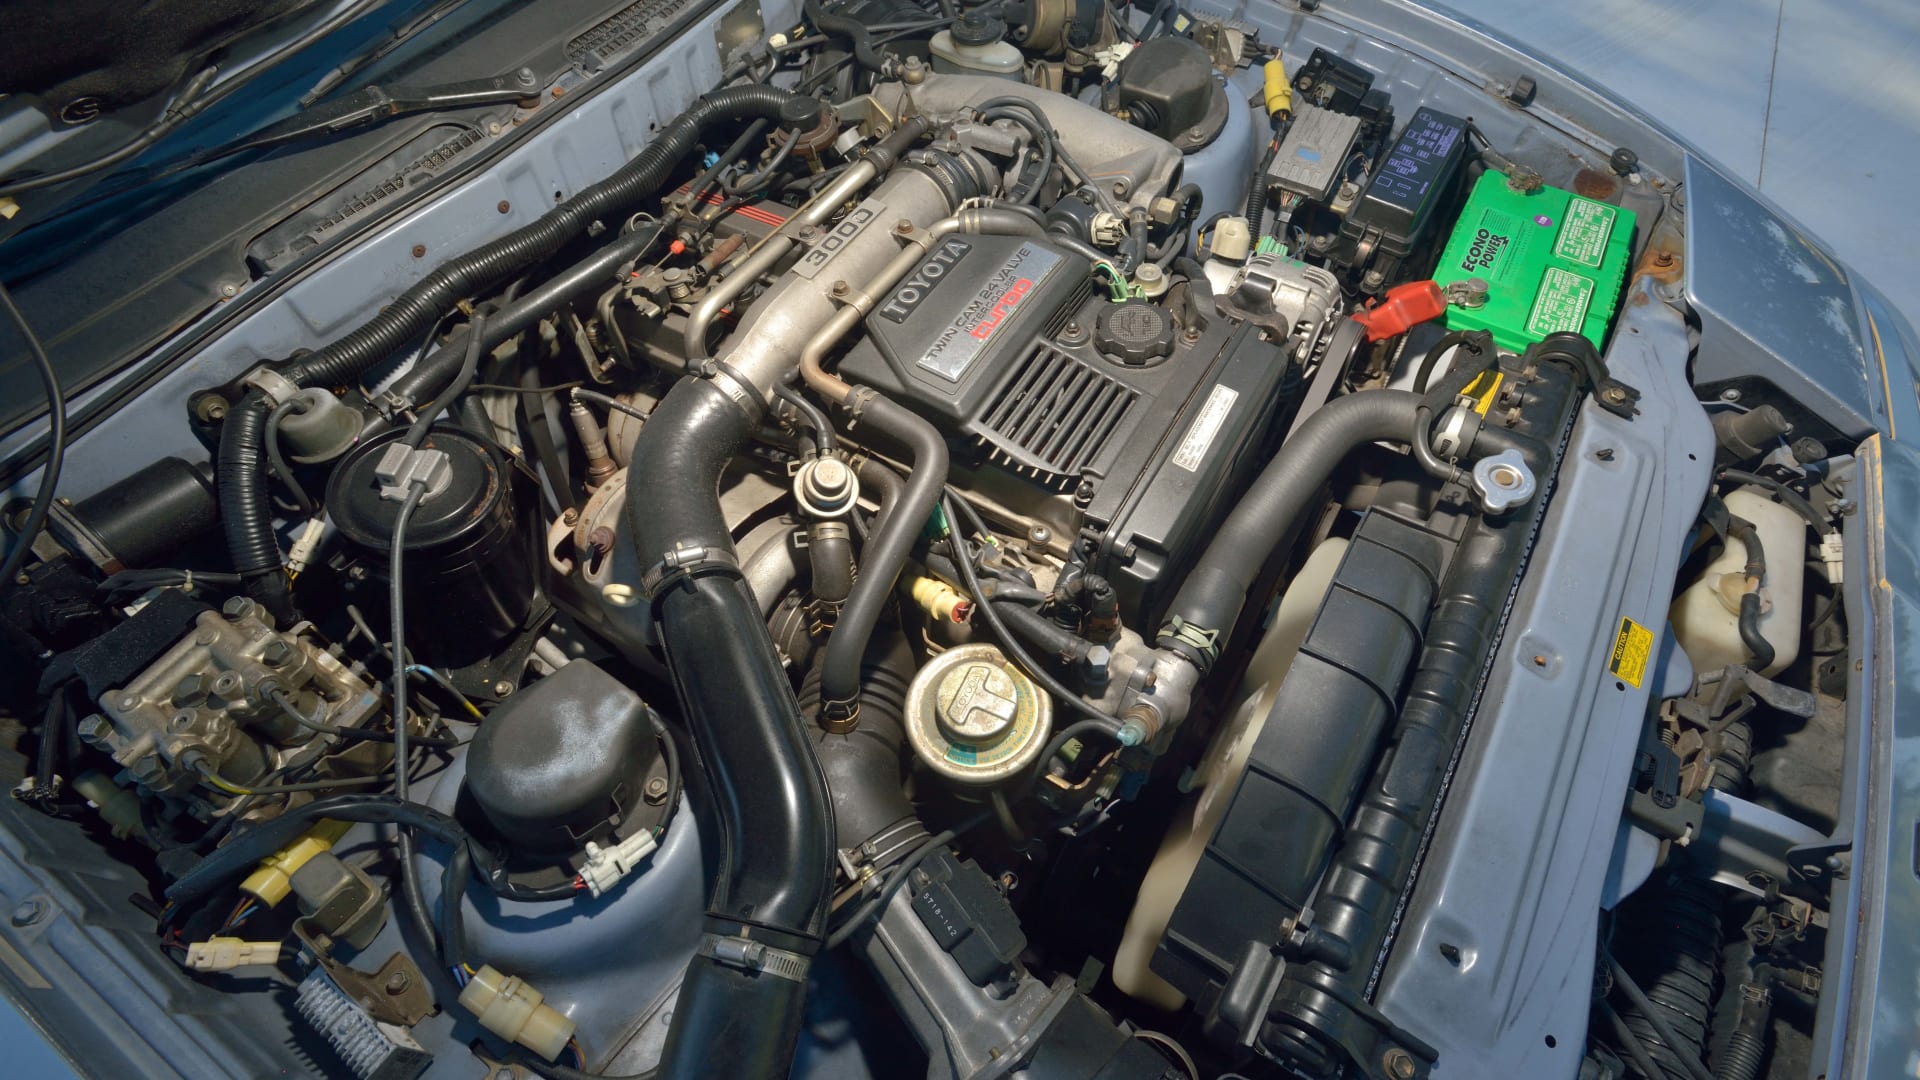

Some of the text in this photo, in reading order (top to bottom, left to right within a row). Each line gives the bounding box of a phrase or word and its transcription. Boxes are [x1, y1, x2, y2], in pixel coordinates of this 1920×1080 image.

[805, 207, 874, 267] 3000
[1461, 228, 1490, 273] ECONO
[1478, 235, 1507, 269] POWER
[883, 239, 970, 314] TOYOTA
[963, 275, 1017, 334] INTERCOOLER
[926, 327, 958, 358] TWIN
[955, 299, 983, 328] CAM
[1615, 632, 1628, 660] CAUTION
